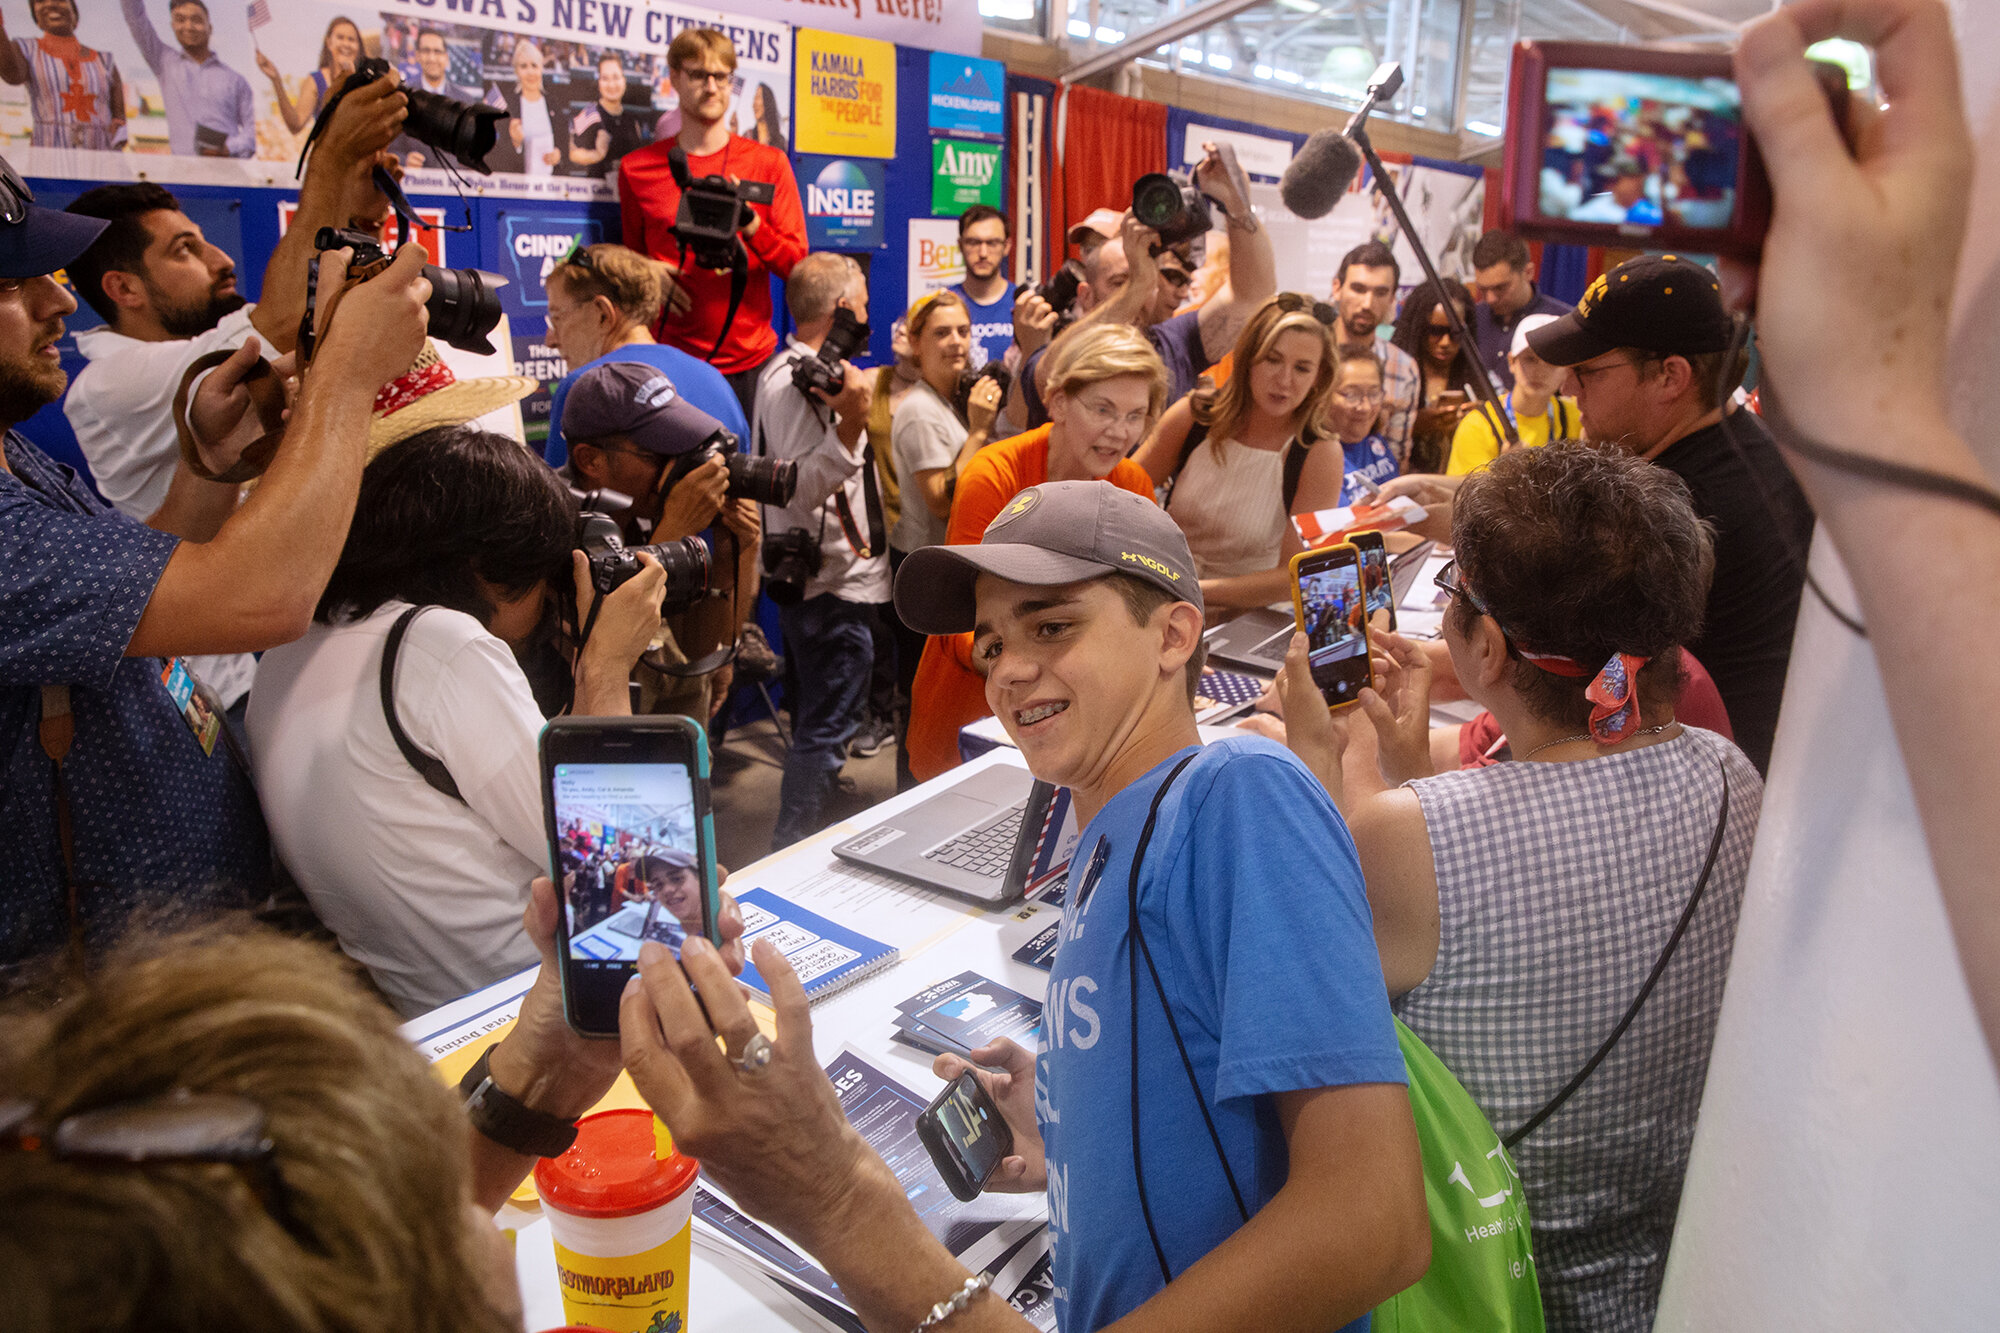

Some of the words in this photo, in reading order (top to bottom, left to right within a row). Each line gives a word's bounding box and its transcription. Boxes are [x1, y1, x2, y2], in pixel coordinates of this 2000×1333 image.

[552, 0, 632, 38] NEW
[811, 50, 864, 78] KAMALA
[811, 75, 858, 99] HARRIS
[859, 81, 882, 102] FOR
[836, 101, 882, 125] PEOPLE
[937, 144, 998, 186] Amy
[806, 183, 875, 217] INSLEE
[1147, 560, 1181, 581] GOLF
[933, 980, 960, 994] IOWA
[482, 1013, 518, 1032] Total
[434, 1030, 481, 1054] During
[1030, 1301, 1052, 1318] THE
